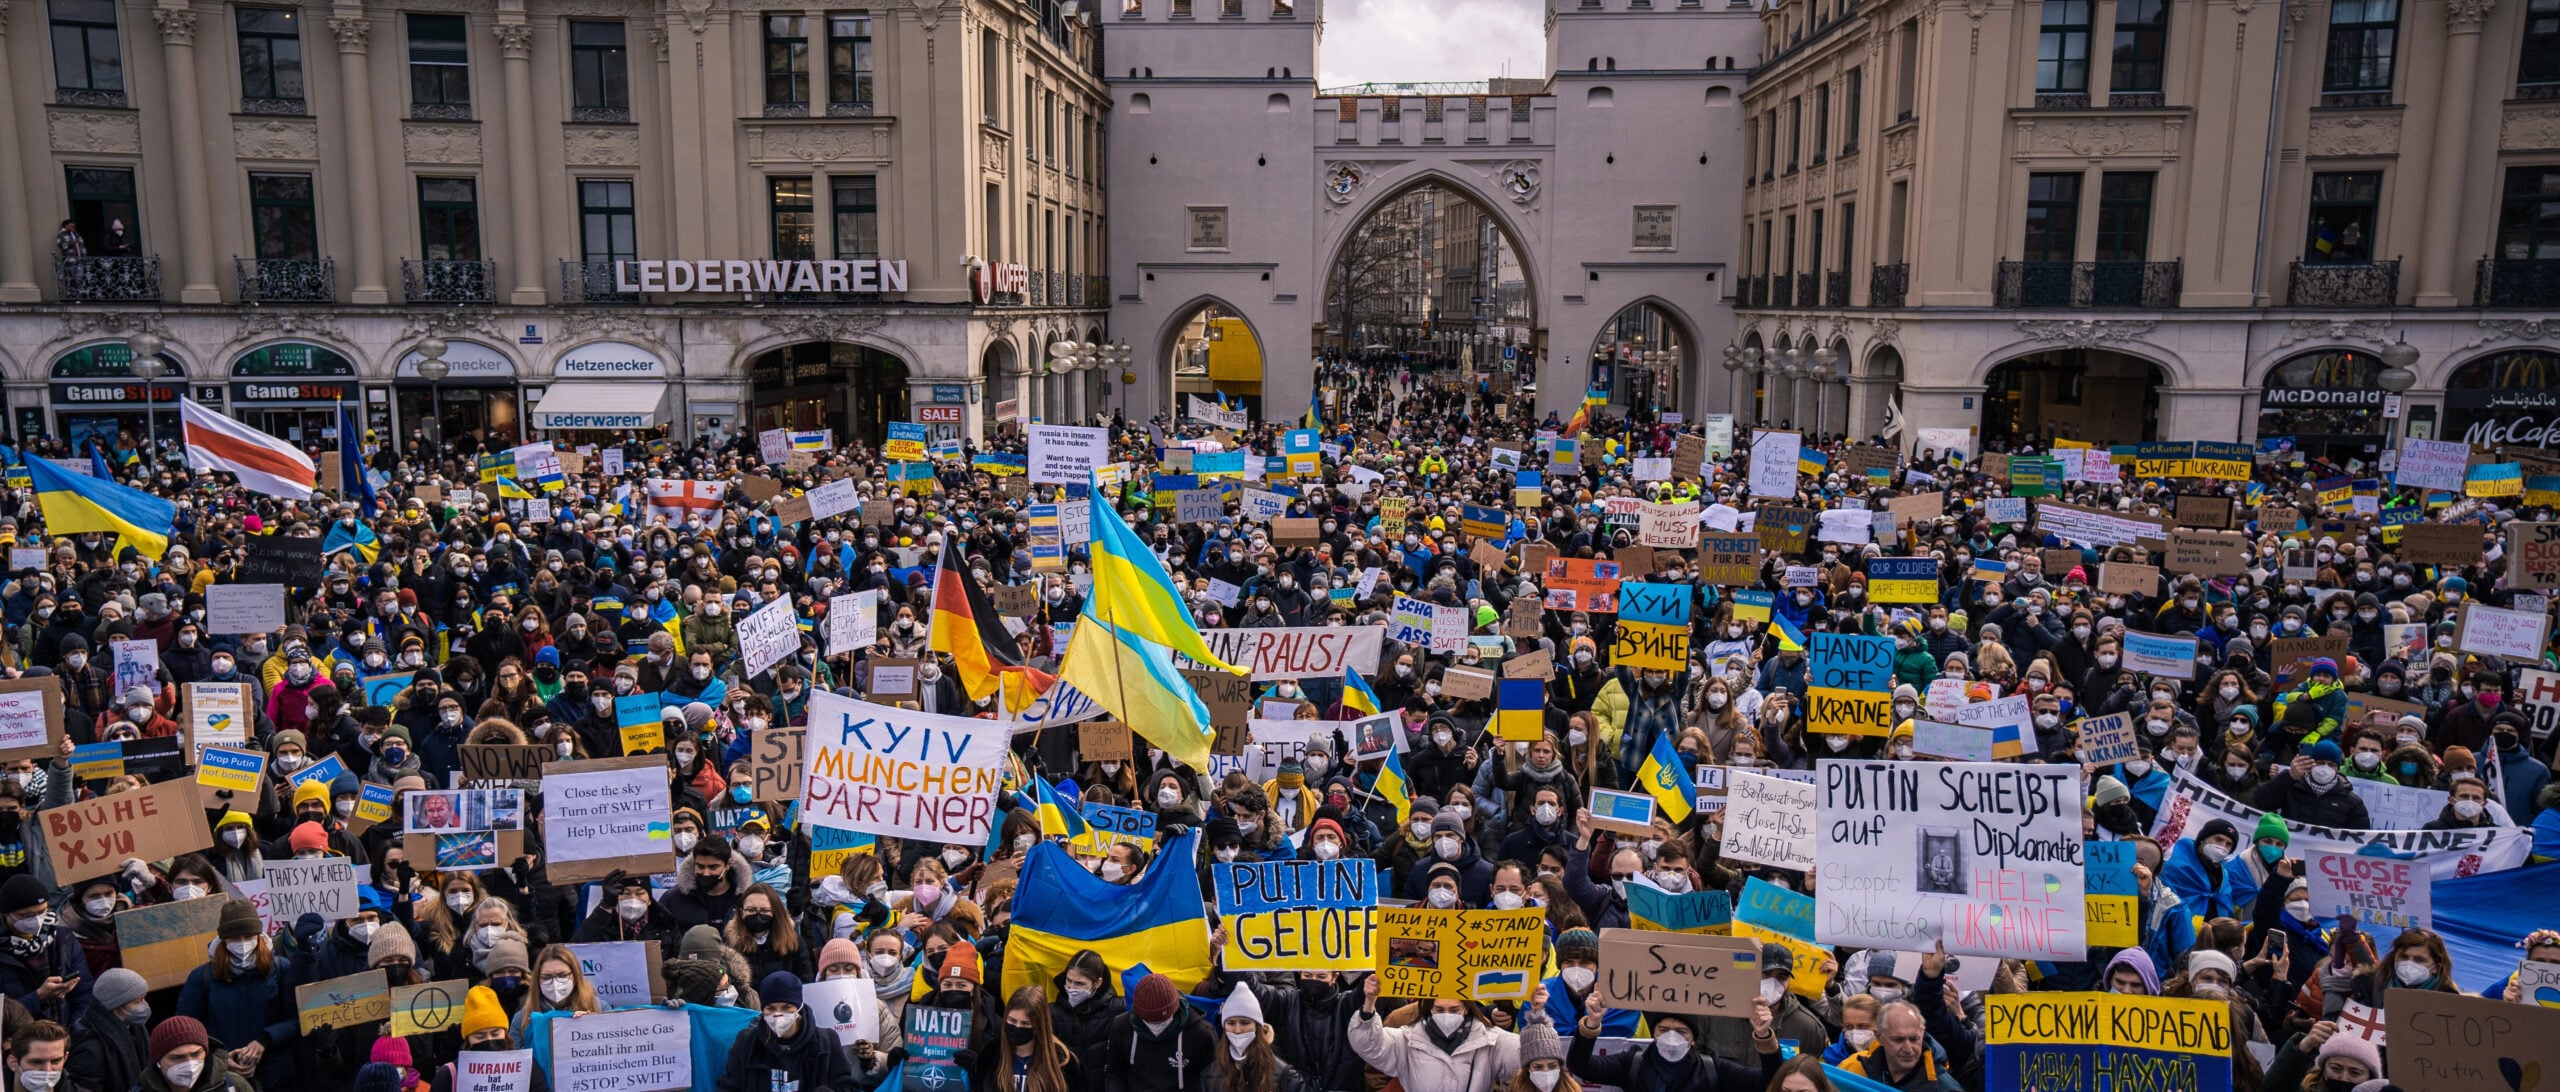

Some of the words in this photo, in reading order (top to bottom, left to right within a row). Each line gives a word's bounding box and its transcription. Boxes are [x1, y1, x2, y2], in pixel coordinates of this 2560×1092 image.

[616, 260, 908, 293] LEDERWAREN
[995, 261, 1030, 292] KOFFER
[565, 359, 654, 372] Hetzenecker
[66, 386, 174, 402] GameStop
[205, 389, 214, 399] 8
[245, 385, 343, 400] GameStop
[545, 413, 643, 428] Lederwaren
[922, 410, 959, 421] SALE
[762, 432, 782, 446] STOP
[2425, 440, 2467, 455] TODAY
[1041, 471, 1058, 480] might
[2138, 459, 2192, 475] SWIFT
[2194, 460, 2248, 478] UKRAINE
[2433, 464, 2465, 478] PUTIN
[1183, 493, 1220, 506] FUCK
[2326, 488, 2350, 501] OFF
[529, 501, 546, 509] STOP
[1182, 506, 1223, 521] PUTIN
[1607, 499, 1640, 515] STOP
[2440, 500, 2476, 521] SHAME
[1606, 512, 1640, 525] PUTIN
[1765, 508, 1813, 525] STAND
[1998, 508, 2027, 520] SHAME
[2261, 509, 2292, 519] PEACE
[2385, 509, 2421, 524] STOP
[1652, 519, 1688, 534] MUSS
[2260, 520, 2297, 531] UKRAINE
[1645, 532, 1686, 546] HELFEN
[1703, 538, 1761, 554] FREIHEIT
[1734, 554, 1752, 565] DIE
[262, 562, 287, 575] fuck
[1702, 566, 1757, 583] UKRAINE
[1870, 562, 1891, 576] OUR
[1896, 562, 1937, 576] SOLDIERS
[1873, 583, 1895, 596] ARE
[1900, 583, 1938, 597] HEROES
[832, 598, 858, 616] BITTE
[1440, 607, 1460, 616] BAN
[1516, 600, 1541, 614] STOP
[831, 613, 860, 632] STOPPT
[1434, 616, 1466, 626] RUSSIA
[1511, 614, 1540, 632] PUTIN
[2474, 611, 2509, 624] RUSSIA
[2493, 621, 2518, 633] PUTIN
[1396, 626, 1432, 647] ASS
[1433, 636, 1467, 651] SWIFT
[1615, 625, 1688, 662] ВОЙНЕ
[2276, 640, 2320, 651] HANDS
[2324, 639, 2343, 651] OFF
[2468, 637, 2508, 649] AGAINST
[2509, 640, 2533, 652] WAR
[122, 641, 150, 652] Russia
[1251, 631, 1353, 676] RAUS!
[1811, 640, 1894, 669] HANDS
[747, 645, 773, 676] STOP
[1824, 669, 1875, 690] OFF
[196, 684, 219, 693] Russian
[219, 684, 239, 694] warship
[1217, 680, 1250, 704] WAR
[620, 705, 642, 716] HEUTE
[643, 703, 657, 713] WIR
[1806, 694, 1892, 729] UKRAINE
[1958, 703, 1988, 721] STOP
[1987, 701, 2008, 718] THE
[2007, 698, 2029, 716] WAR
[4, 721, 24, 731] VON
[1081, 725, 1122, 736] #Stand
[2082, 715, 2123, 737] STAND
[627, 730, 658, 742] MORGEN
[1088, 736, 1112, 747] with
[2093, 733, 2116, 748] WITH
[205, 752, 228, 767] Drop
[229, 756, 256, 768] Putin
[1087, 747, 1129, 760] Ukraine
[2087, 741, 2137, 764] UKRAINE
[460, 747, 499, 779] NO
[201, 767, 217, 777] not
[219, 770, 254, 784] bombs
[364, 788, 394, 801] #Stand
[564, 785, 603, 800] Close
[603, 784, 620, 797] the
[621, 782, 643, 799] sky
[48, 795, 158, 838] ВОЙНЕ
[558, 804, 587, 818] Turn
[591, 805, 610, 816] off
[611, 798, 655, 813] SWIFT
[567, 825, 597, 841] Help
[598, 820, 646, 835] Ukraine
[1089, 808, 1156, 836] STOP
[813, 823, 858, 849] STAND
[1831, 815, 1887, 848] auf
[1973, 817, 2084, 872] Diplomatie
[311, 865, 326, 884] WE
[323, 863, 353, 884] NEED
[1822, 862, 1902, 896] Stoppt
[2318, 855, 2413, 887] CLOSE
[1230, 859, 1363, 908] PUTIN
[1973, 868, 2062, 904] HELP
[2328, 877, 2364, 892] THE
[2371, 883, 2409, 899] SKY
[270, 888, 340, 921] DEMOCRACY
[1633, 884, 1692, 930] STOP
[1690, 891, 1730, 923] WAR
[2349, 893, 2405, 912] HELP
[1383, 911, 1422, 927] ИДИ
[1426, 914, 1449, 930] НА
[1469, 915, 1543, 933] #STAND
[2335, 904, 2420, 929] UKRAINE
[1235, 905, 1318, 961] GET
[1953, 902, 2073, 957] UKRAINE
[1480, 936, 1530, 950] WITH
[581, 959, 603, 974] No
[1468, 952, 1537, 970] UKRAINE
[1648, 943, 1719, 980] Save
[1383, 967, 1410, 981] GO
[1416, 969, 1443, 984] TO
[1391, 981, 1440, 998] HELL
[1609, 967, 1727, 1010] Ukraine
[309, 1004, 361, 1029] PEACE
[914, 1008, 963, 1037] NATO
[1989, 997, 2100, 1040] РУССКИЙ
[2110, 1004, 2231, 1051] КОРАБЛЬ
[570, 1029, 594, 1042] Das
[596, 1024, 650, 1040] russische
[651, 1023, 675, 1036] Gas
[2408, 1010, 2513, 1049] STOP
[907, 1032, 926, 1046] Help
[927, 1036, 968, 1050] UKRAINE!
[570, 1045, 614, 1060] bezahlt
[616, 1044, 634, 1056] ihr
[636, 1041, 655, 1053] mit
[922, 1047, 948, 1059] Against
[467, 1061, 523, 1075] UKRAINE
[571, 1058, 649, 1075] ukrainischem
[651, 1053, 677, 1067] Blut
[2018, 1050, 2082, 1092] ИДИ
[2092, 1050, 2198, 1092] НАХУЙ
[2413, 1056, 2484, 1081] Putin
[473, 1083, 490, 1092] das
[490, 1082, 514, 1092] Recht
[487, 1074, 502, 1085] hat
[571, 1069, 675, 1092] #STOP_SWIFT
